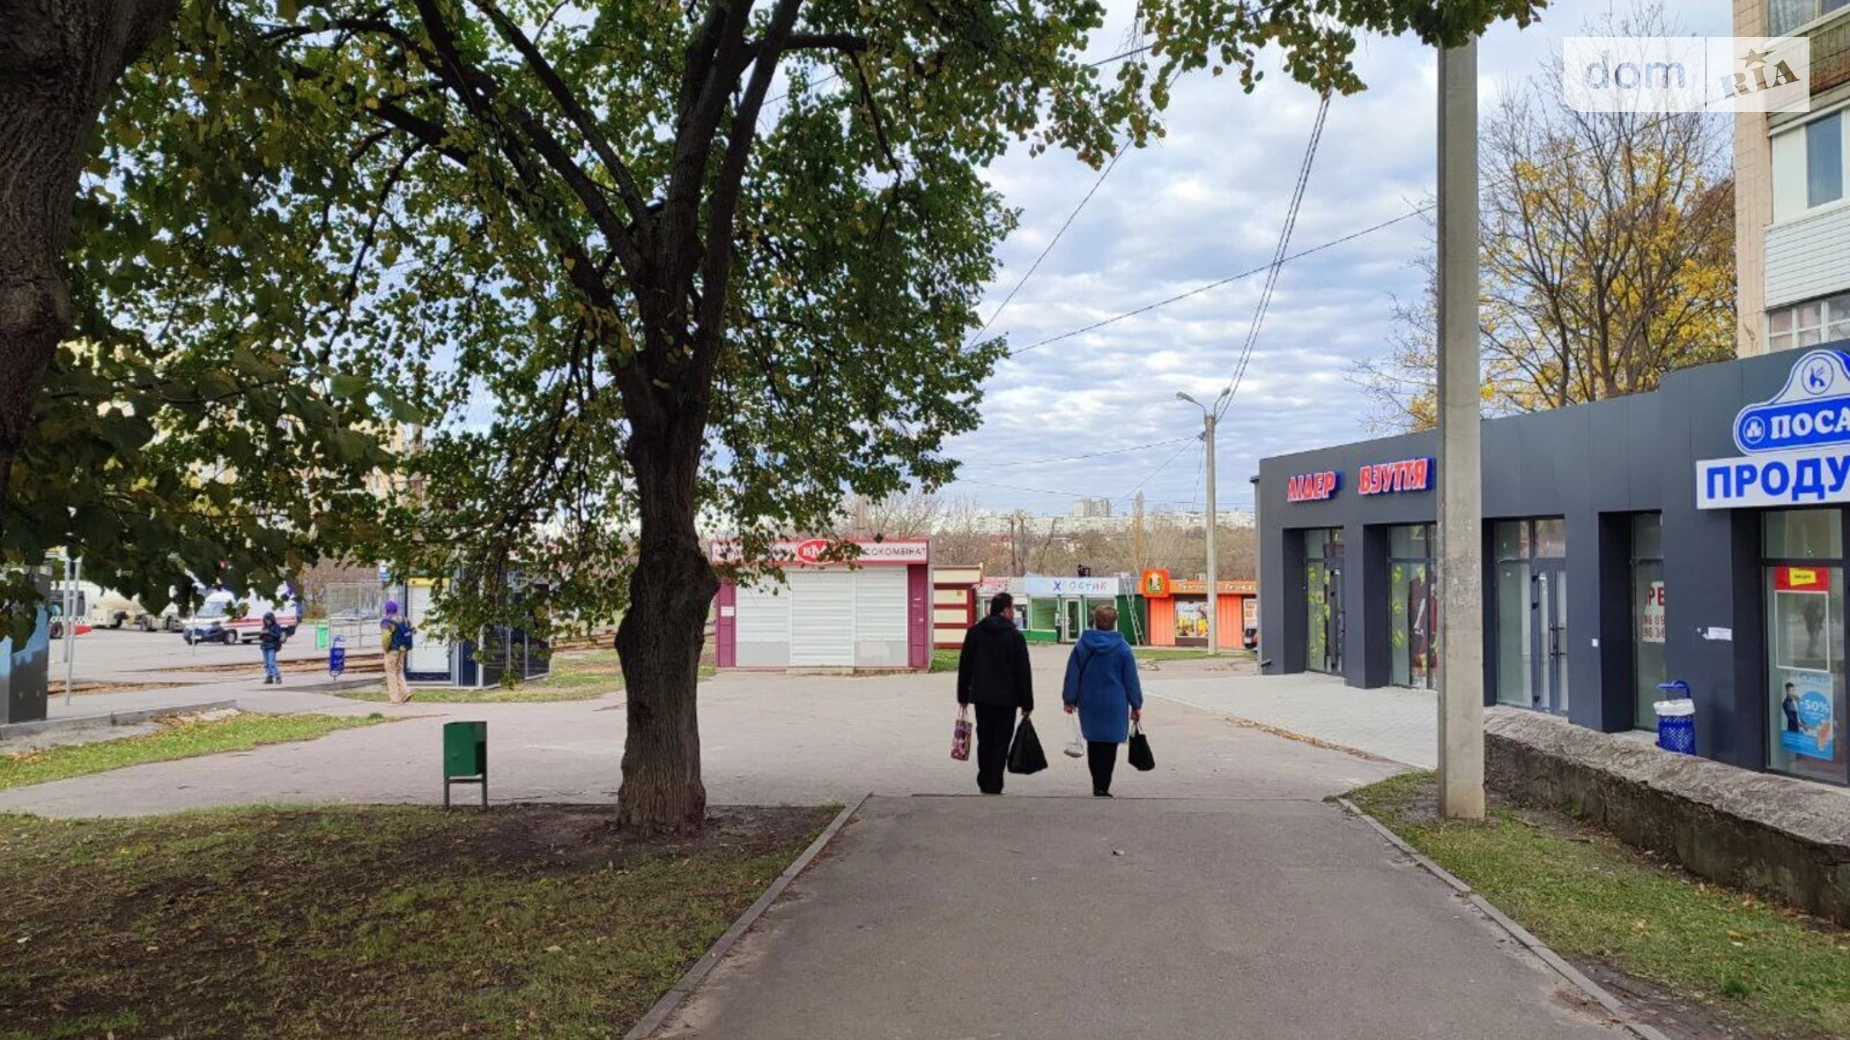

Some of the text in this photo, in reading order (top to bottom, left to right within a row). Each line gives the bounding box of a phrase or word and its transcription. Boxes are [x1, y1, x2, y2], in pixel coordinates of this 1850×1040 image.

[1287, 457, 1428, 502] ЛІДЕР ВЗУТТЯ
[1707, 455, 1850, 502] ПРОДУ
